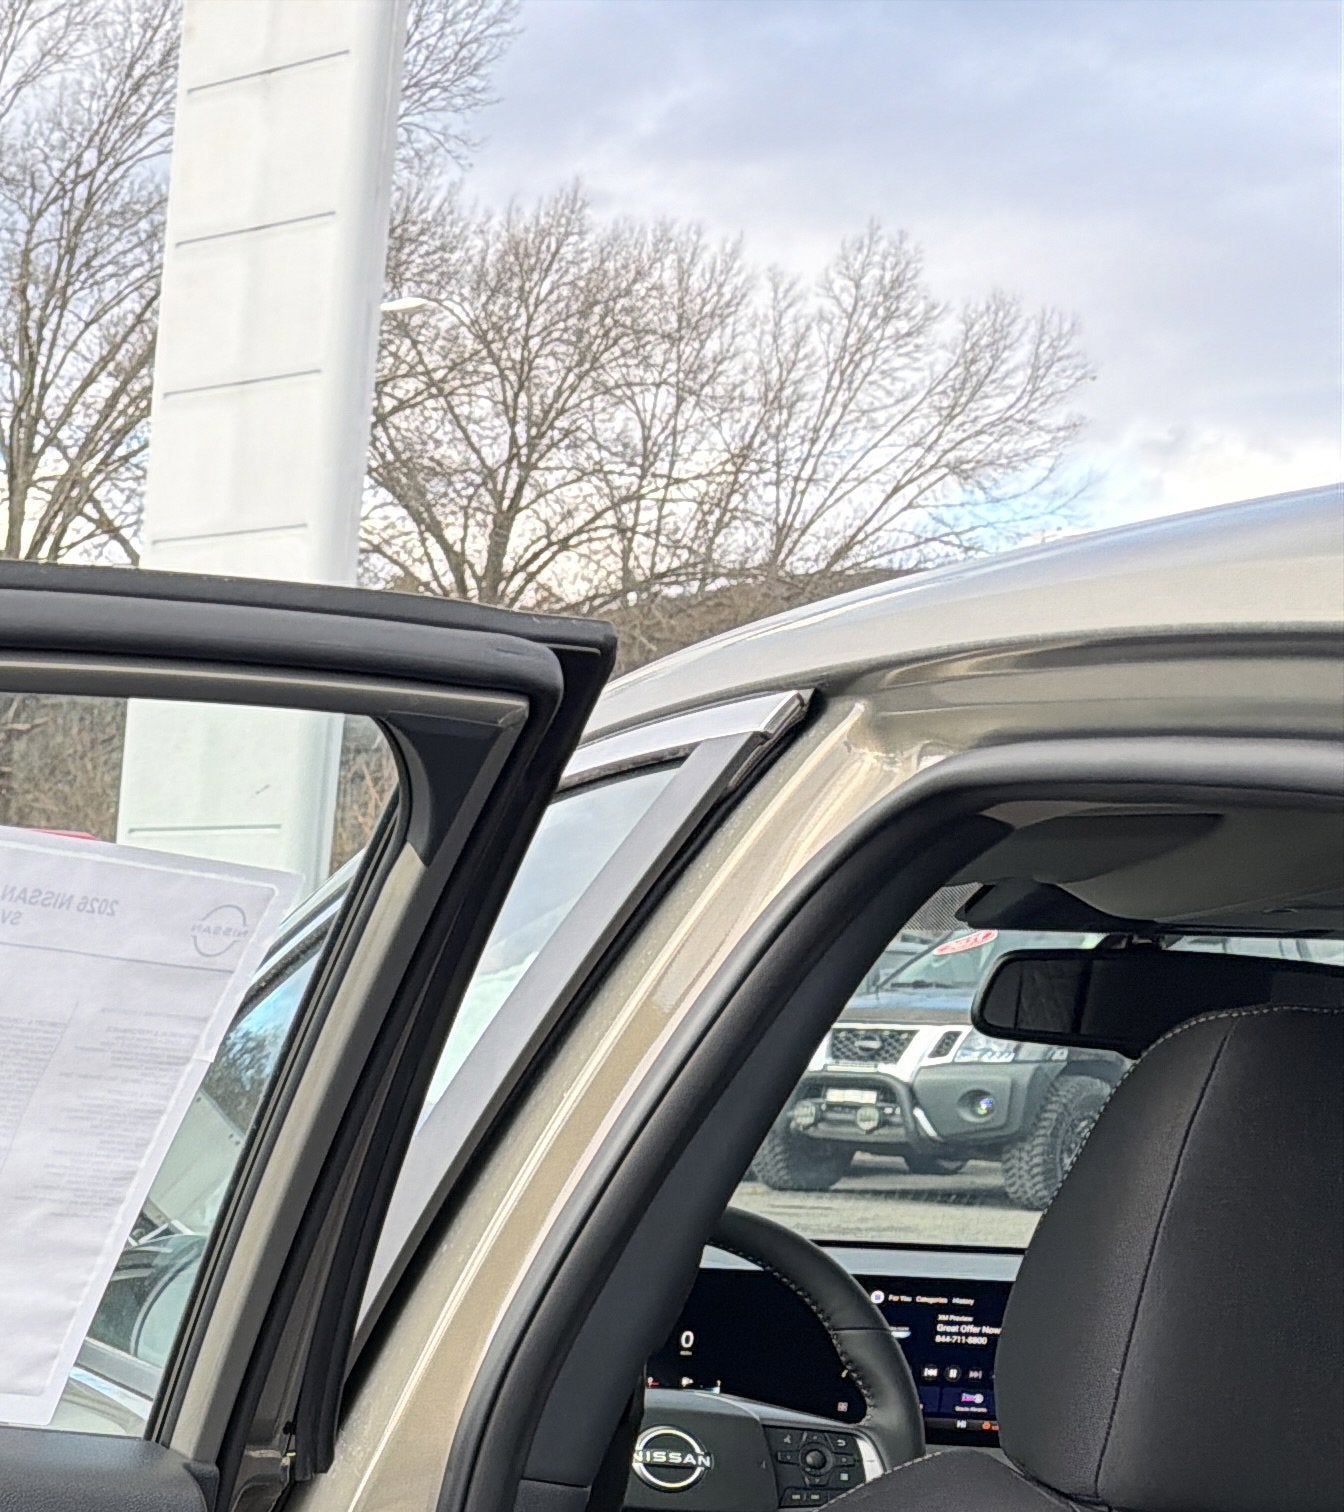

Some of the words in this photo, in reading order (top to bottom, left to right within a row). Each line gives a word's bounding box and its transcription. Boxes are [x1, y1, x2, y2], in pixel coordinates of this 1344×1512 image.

[936, 1323, 958, 1333] Great
[960, 1324, 980, 1335] Offer
[681, 1330, 694, 1348] 0
[633, 1450, 711, 1468] NISSAN
